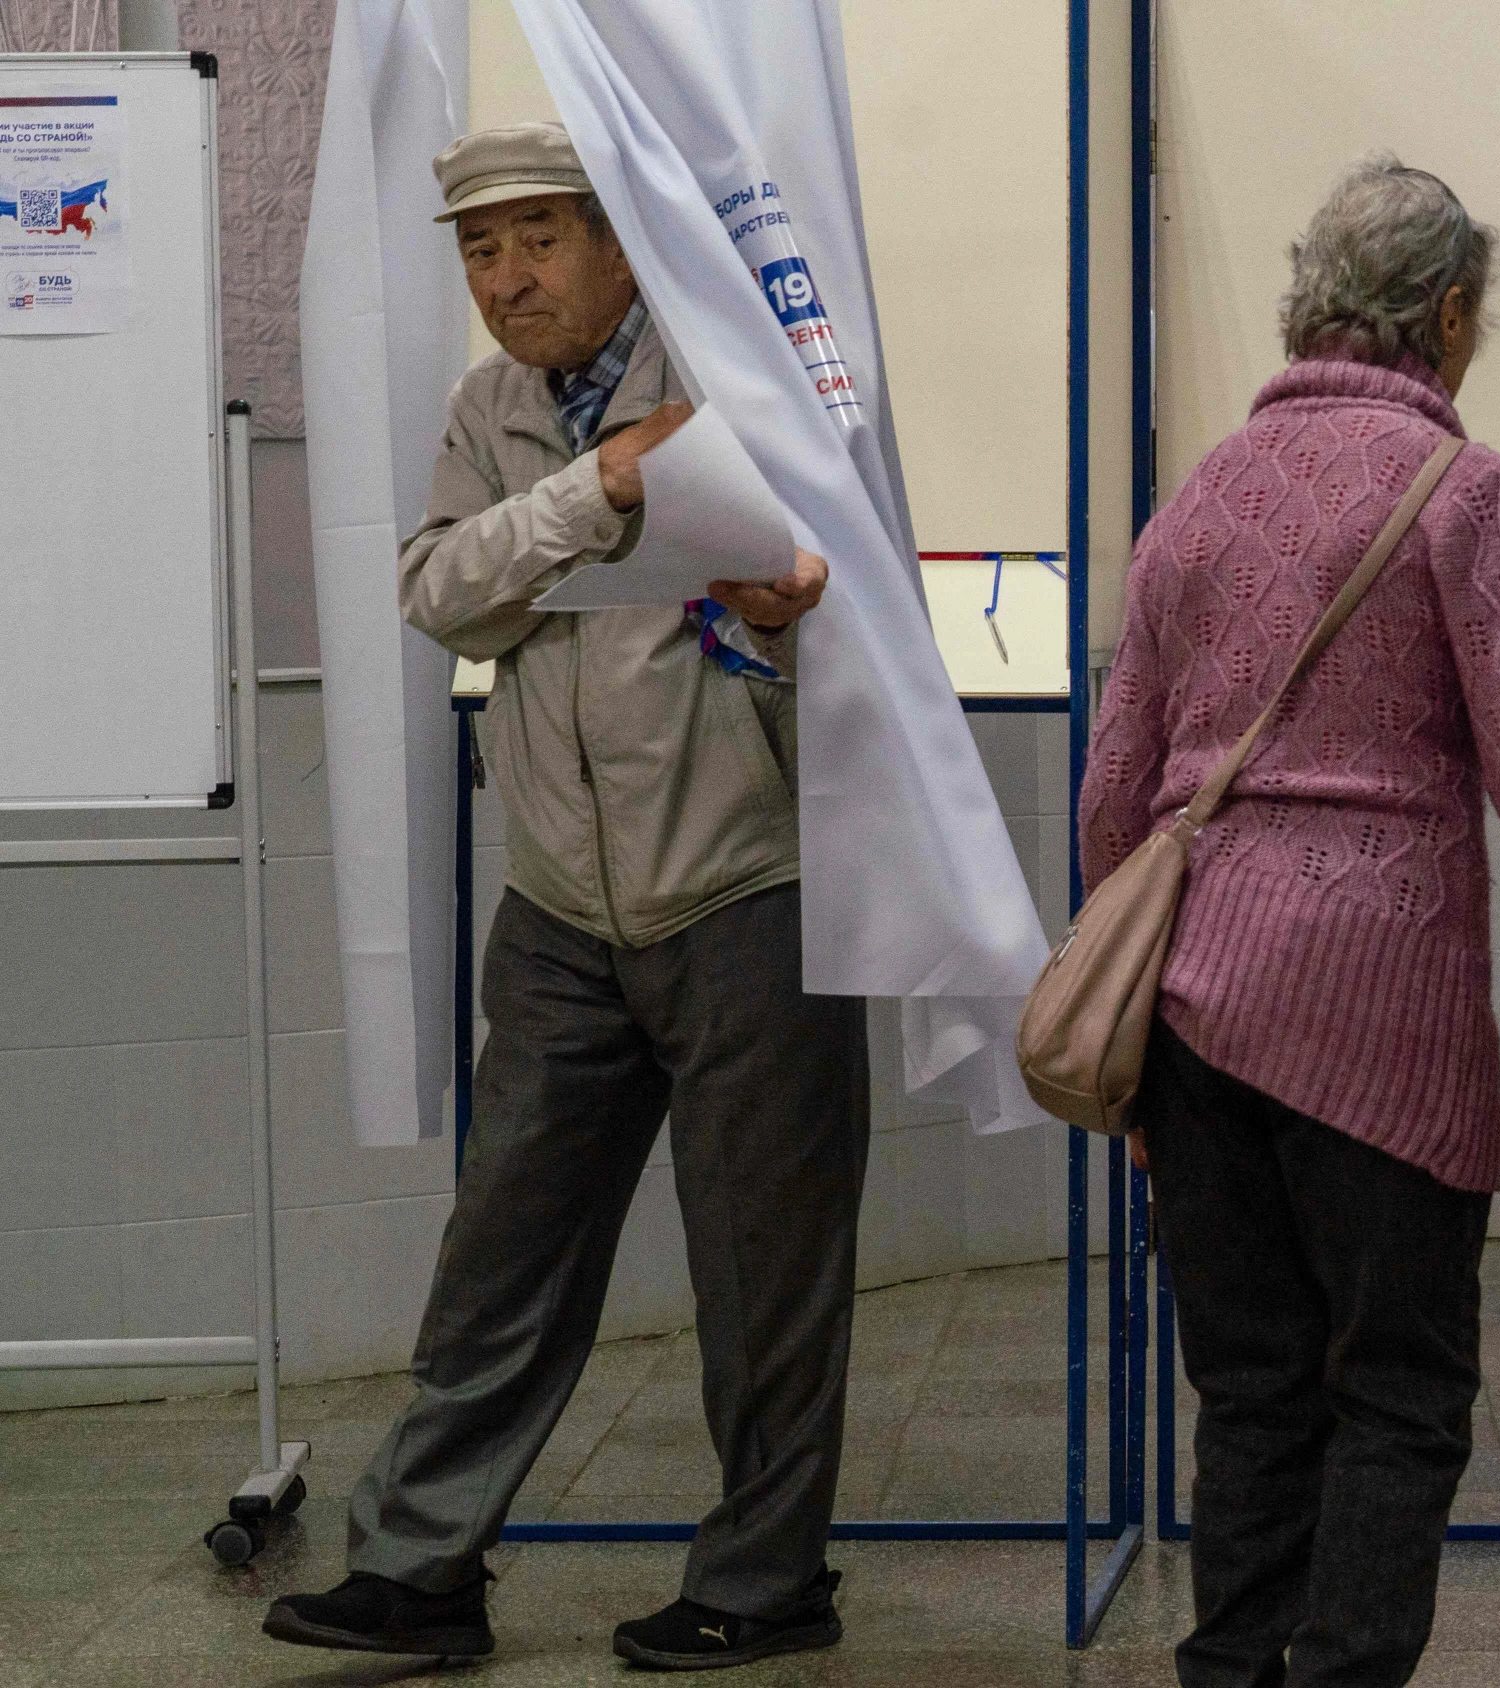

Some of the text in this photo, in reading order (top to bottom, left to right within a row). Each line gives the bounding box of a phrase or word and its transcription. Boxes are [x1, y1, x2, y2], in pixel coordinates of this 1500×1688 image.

[12, 123, 54, 133] участие
[64, 122, 95, 131] акции
[16, 133, 32, 142] СО
[33, 131, 94, 142] СТРАНОЙ!»
[713, 182, 780, 219] БОРЫ Д
[728, 211, 791, 245] АРСТВЕ
[38, 275, 72, 286] БУДЬ
[768, 272, 813, 314] 19
